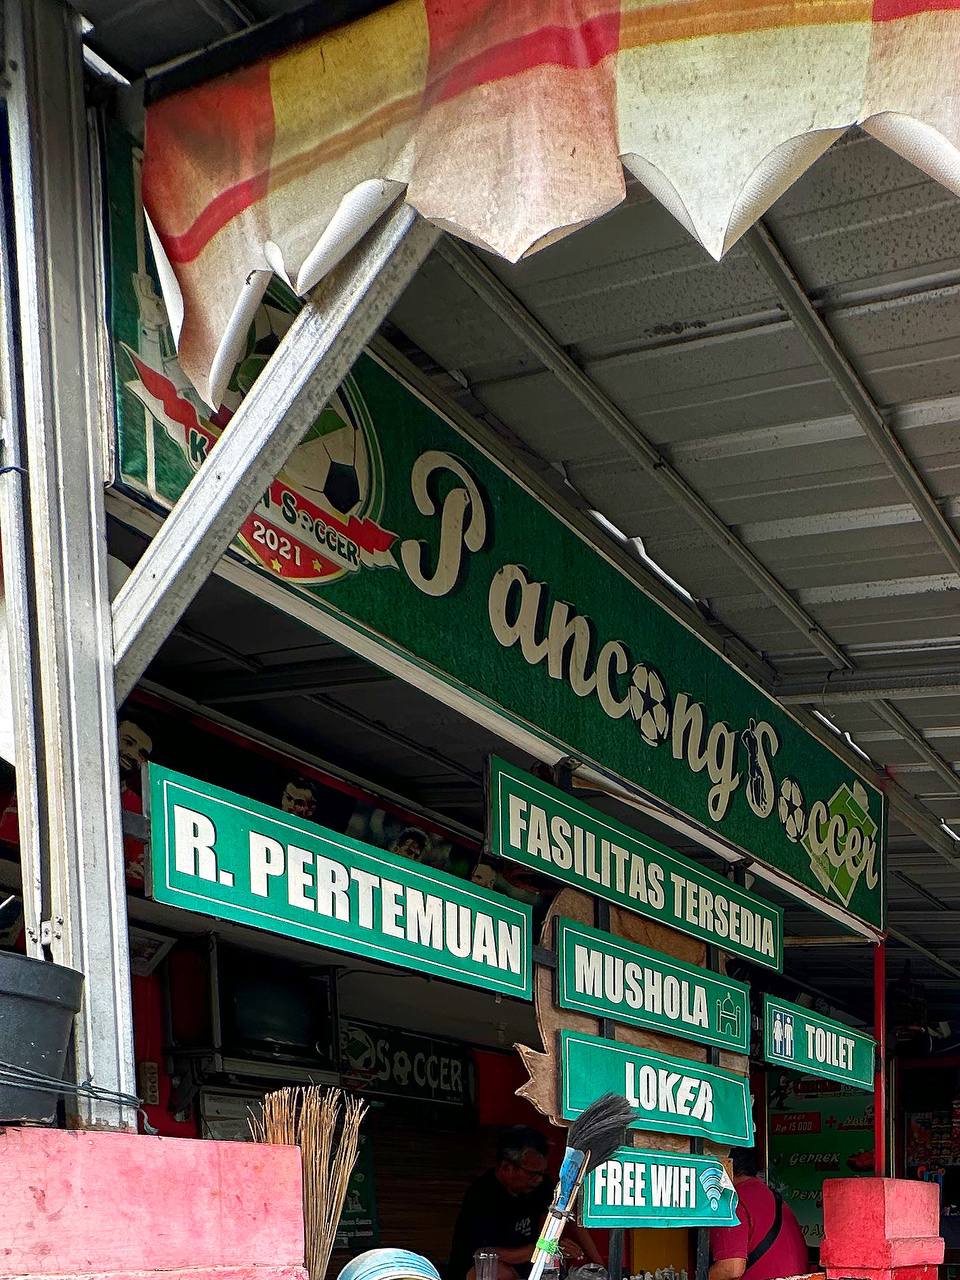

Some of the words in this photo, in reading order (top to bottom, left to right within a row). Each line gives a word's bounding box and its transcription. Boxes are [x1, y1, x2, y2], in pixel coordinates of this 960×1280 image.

[253, 521, 301, 566] 2021
[173, 804, 234, 887] R.
[249, 830, 522, 974] PERTEMUAN
[508, 794, 665, 910] FASILITAS
[672, 875, 775, 959] TERSEDIA
[574, 944, 710, 1029] MUSHOLA
[806, 1023, 854, 1072] TOILET
[625, 1062, 714, 1124] LOKER
[594, 1160, 646, 1207] FREE
[651, 1164, 697, 1209] WIFI
